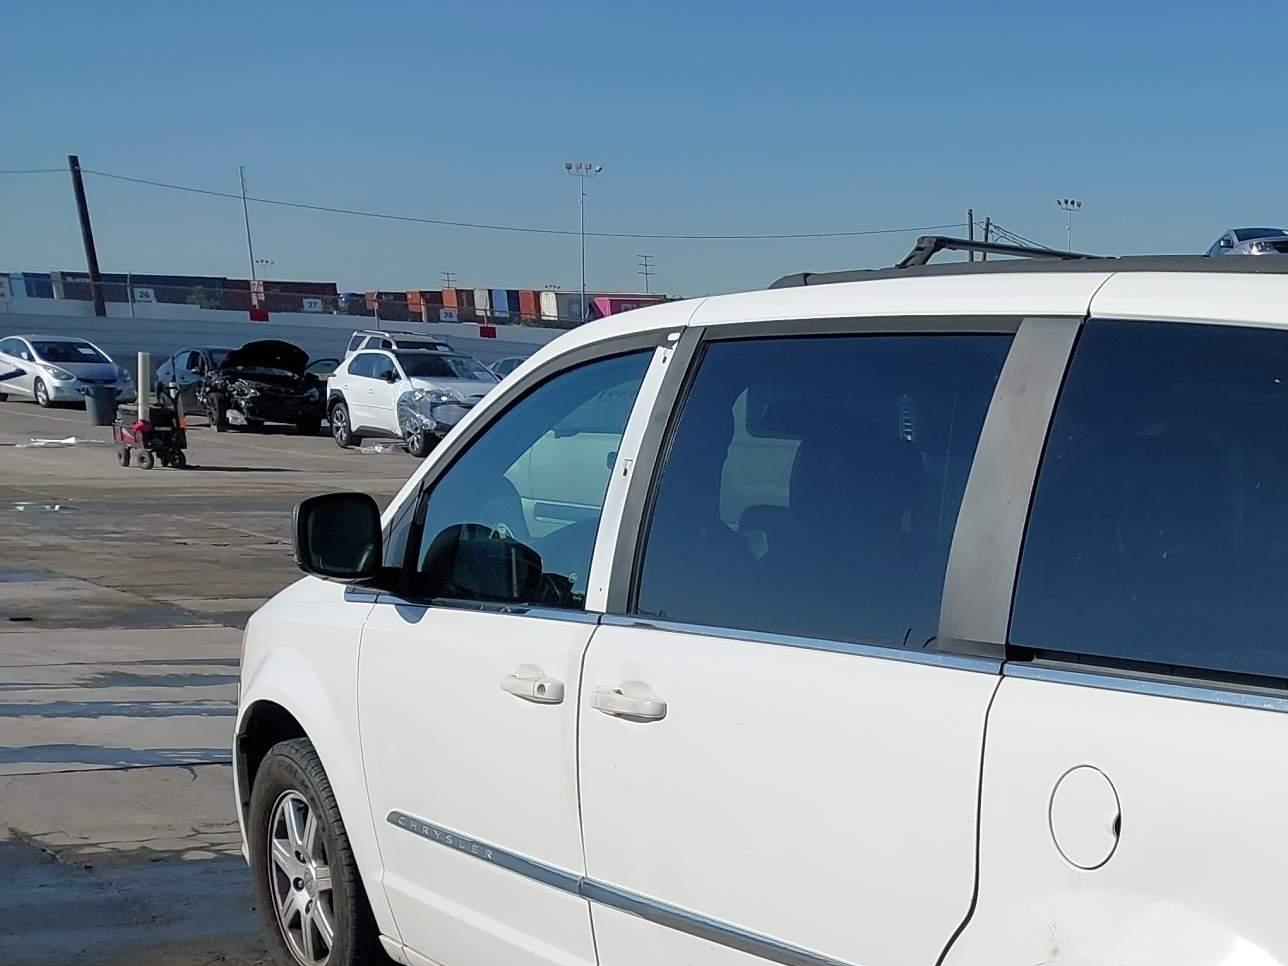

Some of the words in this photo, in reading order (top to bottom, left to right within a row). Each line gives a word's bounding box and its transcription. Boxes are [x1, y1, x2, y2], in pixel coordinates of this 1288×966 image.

[139, 290, 149, 299] 26
[307, 301, 318, 309] 27
[397, 816, 494, 859] CHRYSLER
